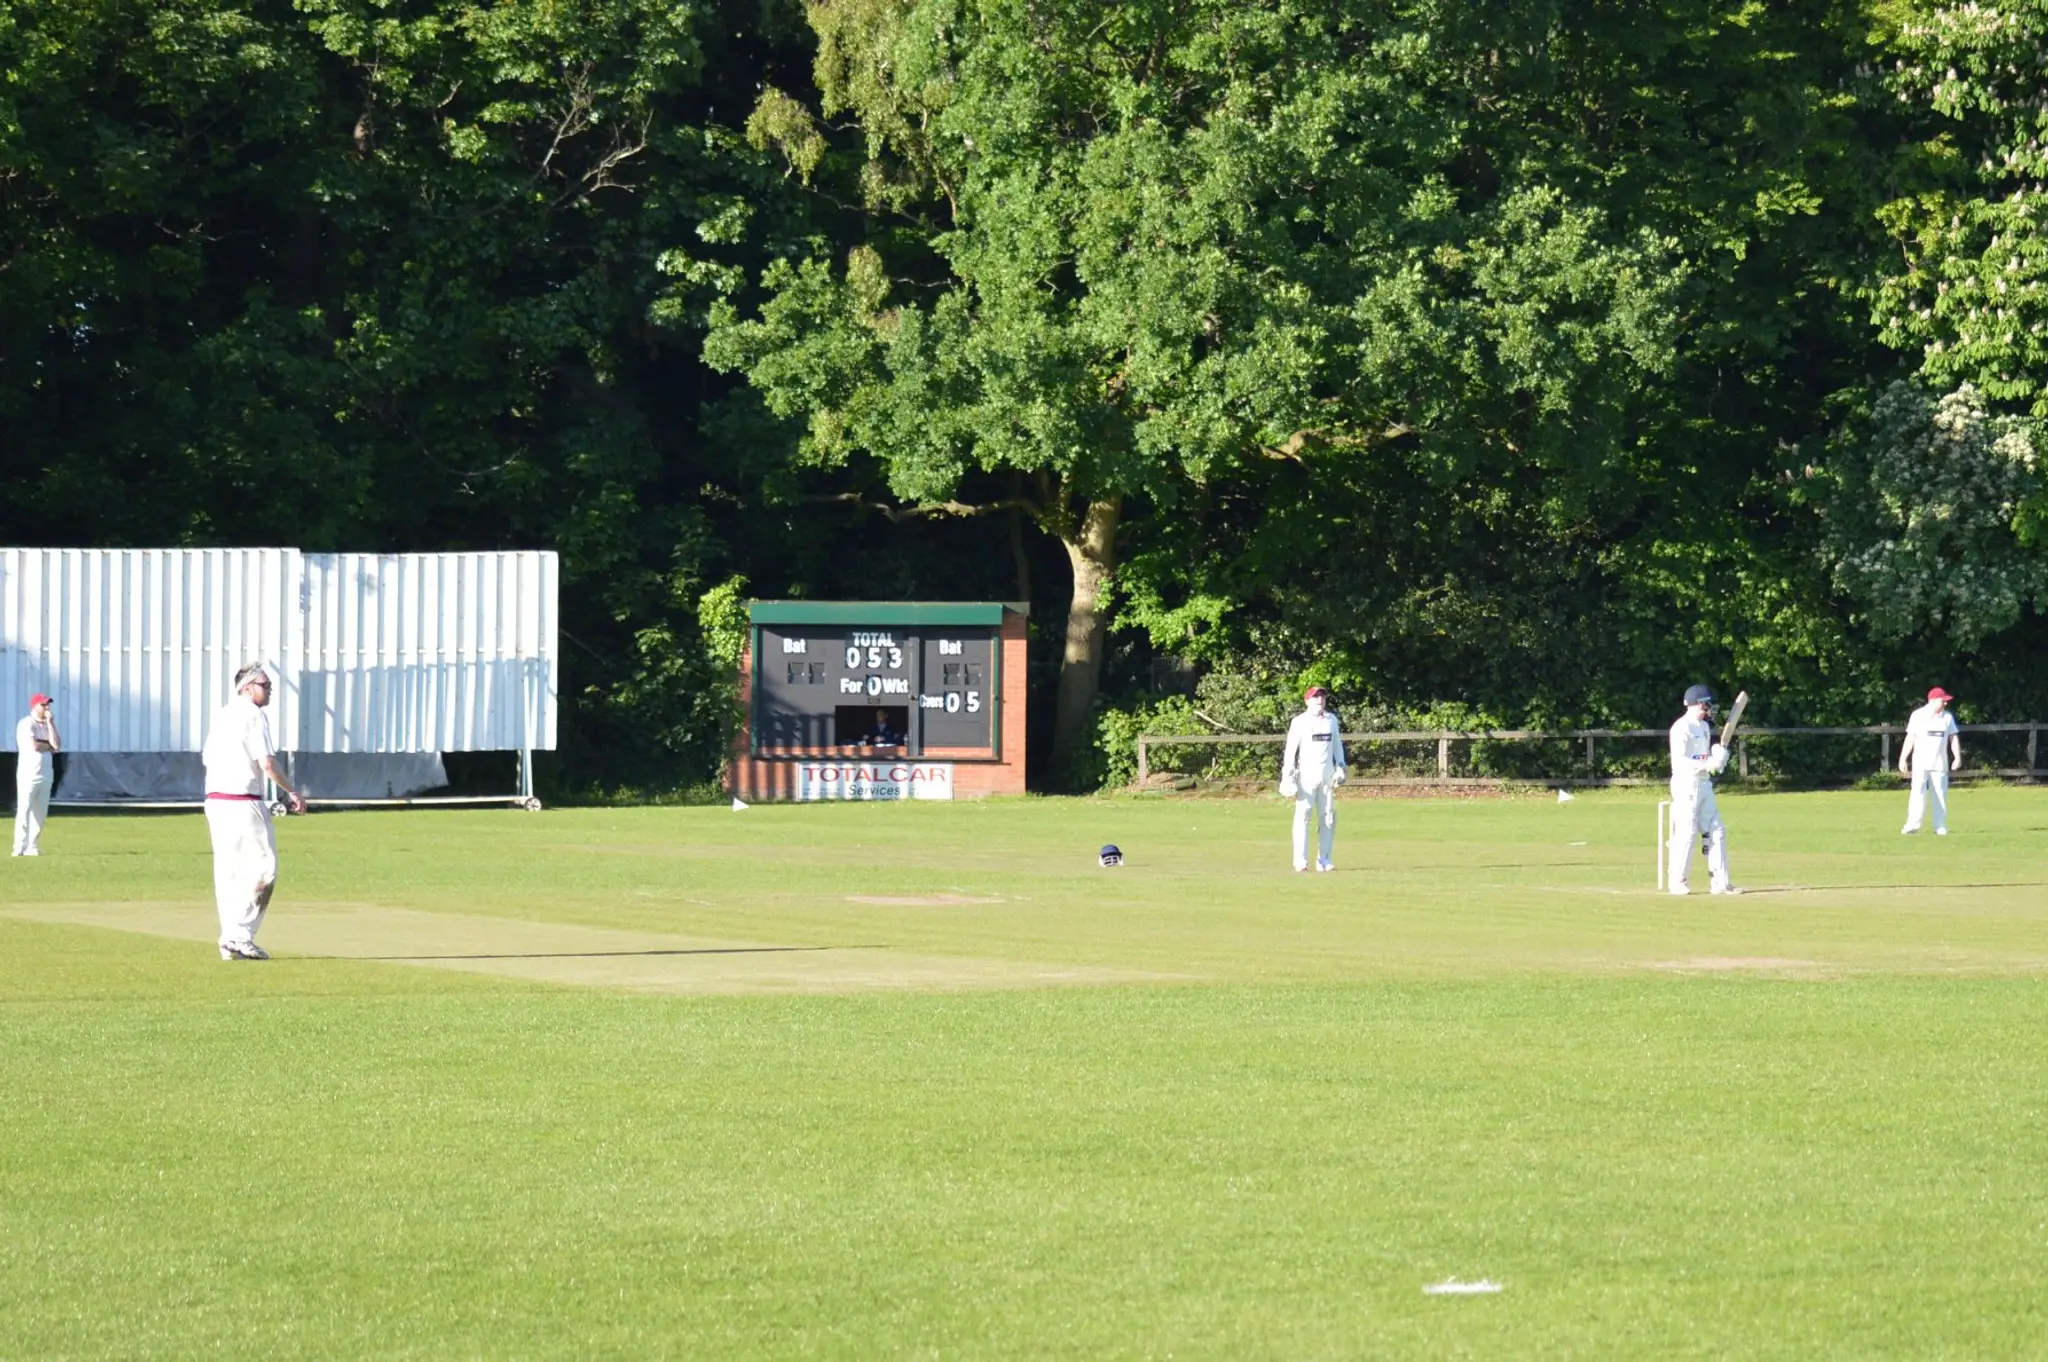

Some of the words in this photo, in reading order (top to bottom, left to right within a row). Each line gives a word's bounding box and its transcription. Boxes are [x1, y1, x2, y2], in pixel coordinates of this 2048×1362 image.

[783, 638, 807, 653] Bat
[852, 632, 896, 648] TOTAL
[939, 638, 962, 655] Bat
[840, 678, 864, 693] For
[867, 676, 882, 696] 0
[882, 678, 909, 693] Wkt
[919, 693, 944, 708] Overs
[848, 785, 901, 797] Services
